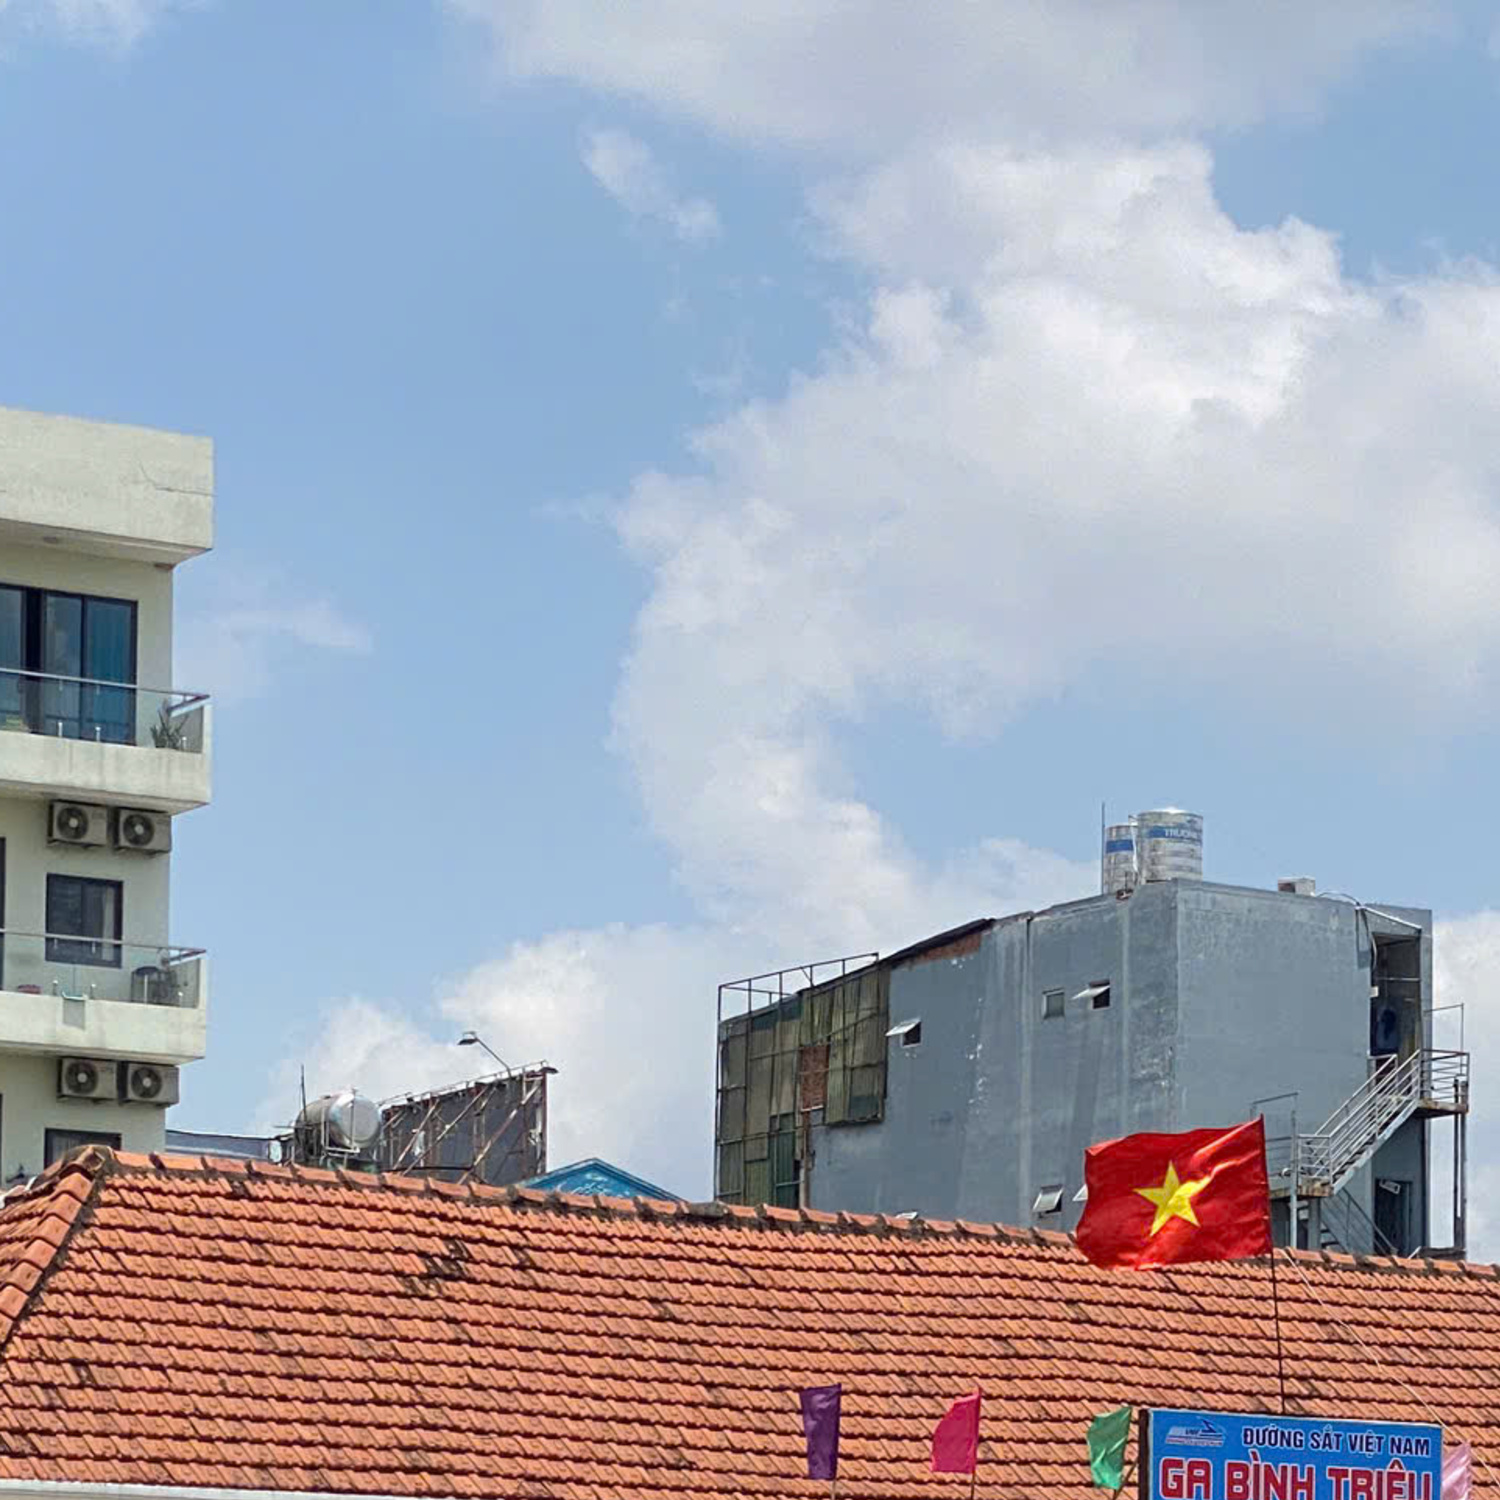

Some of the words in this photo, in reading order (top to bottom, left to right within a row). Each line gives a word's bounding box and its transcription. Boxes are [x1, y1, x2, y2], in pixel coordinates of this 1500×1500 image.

[1243, 1424, 1303, 1448] ĐƯỜNG
[1310, 1424, 1344, 1452] SẮT
[1347, 1430, 1385, 1459] VIỆT
[1389, 1436, 1431, 1458] NAM
